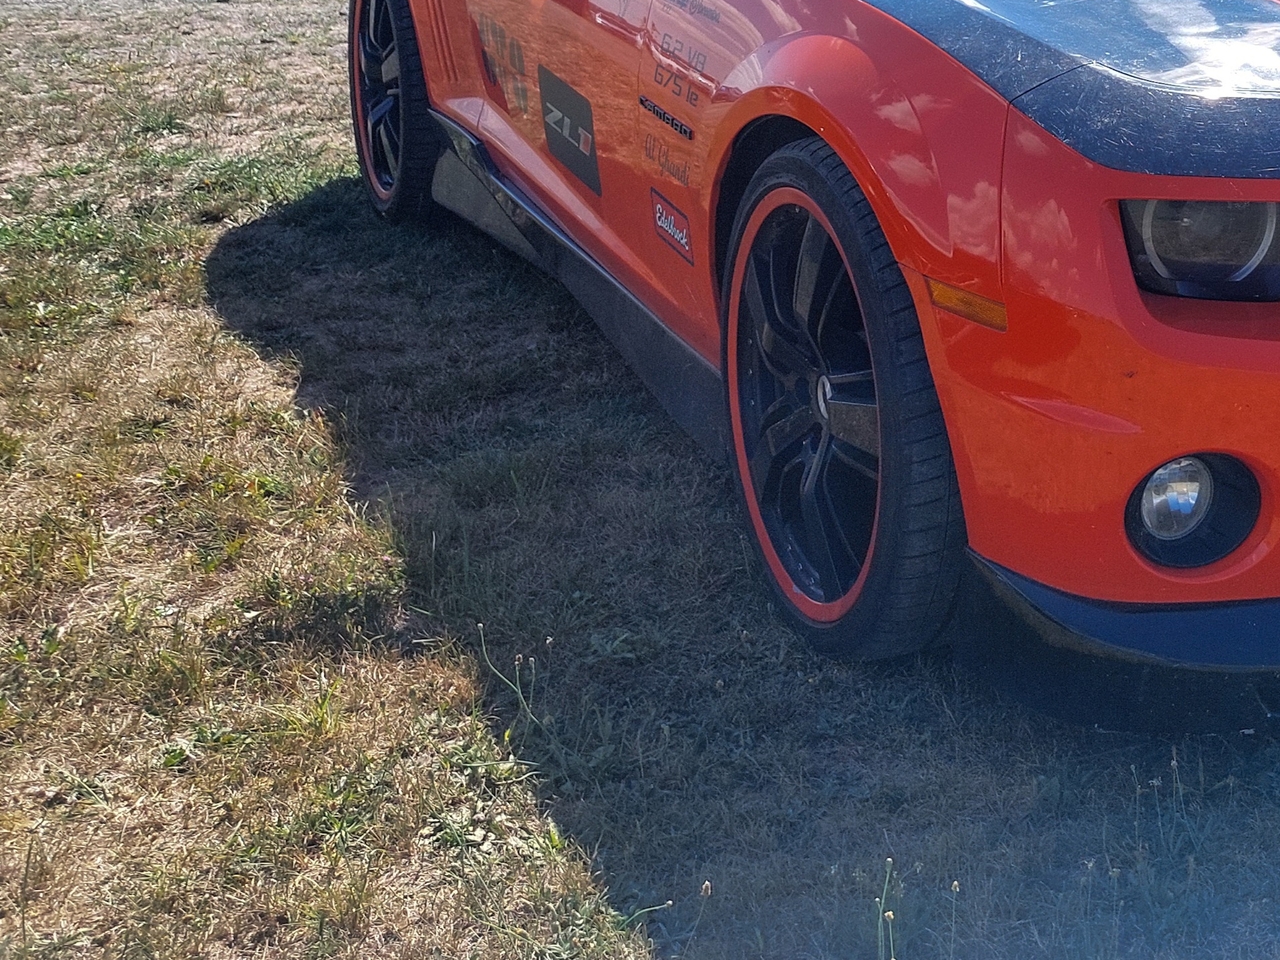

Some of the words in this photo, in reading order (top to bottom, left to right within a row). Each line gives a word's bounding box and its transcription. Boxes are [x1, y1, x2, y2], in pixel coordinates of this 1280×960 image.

[687, 46, 708, 73] V8
[654, 64, 683, 97] 675
[544, 101, 593, 157] ZL1
[655, 203, 689, 251] Edelbrock
